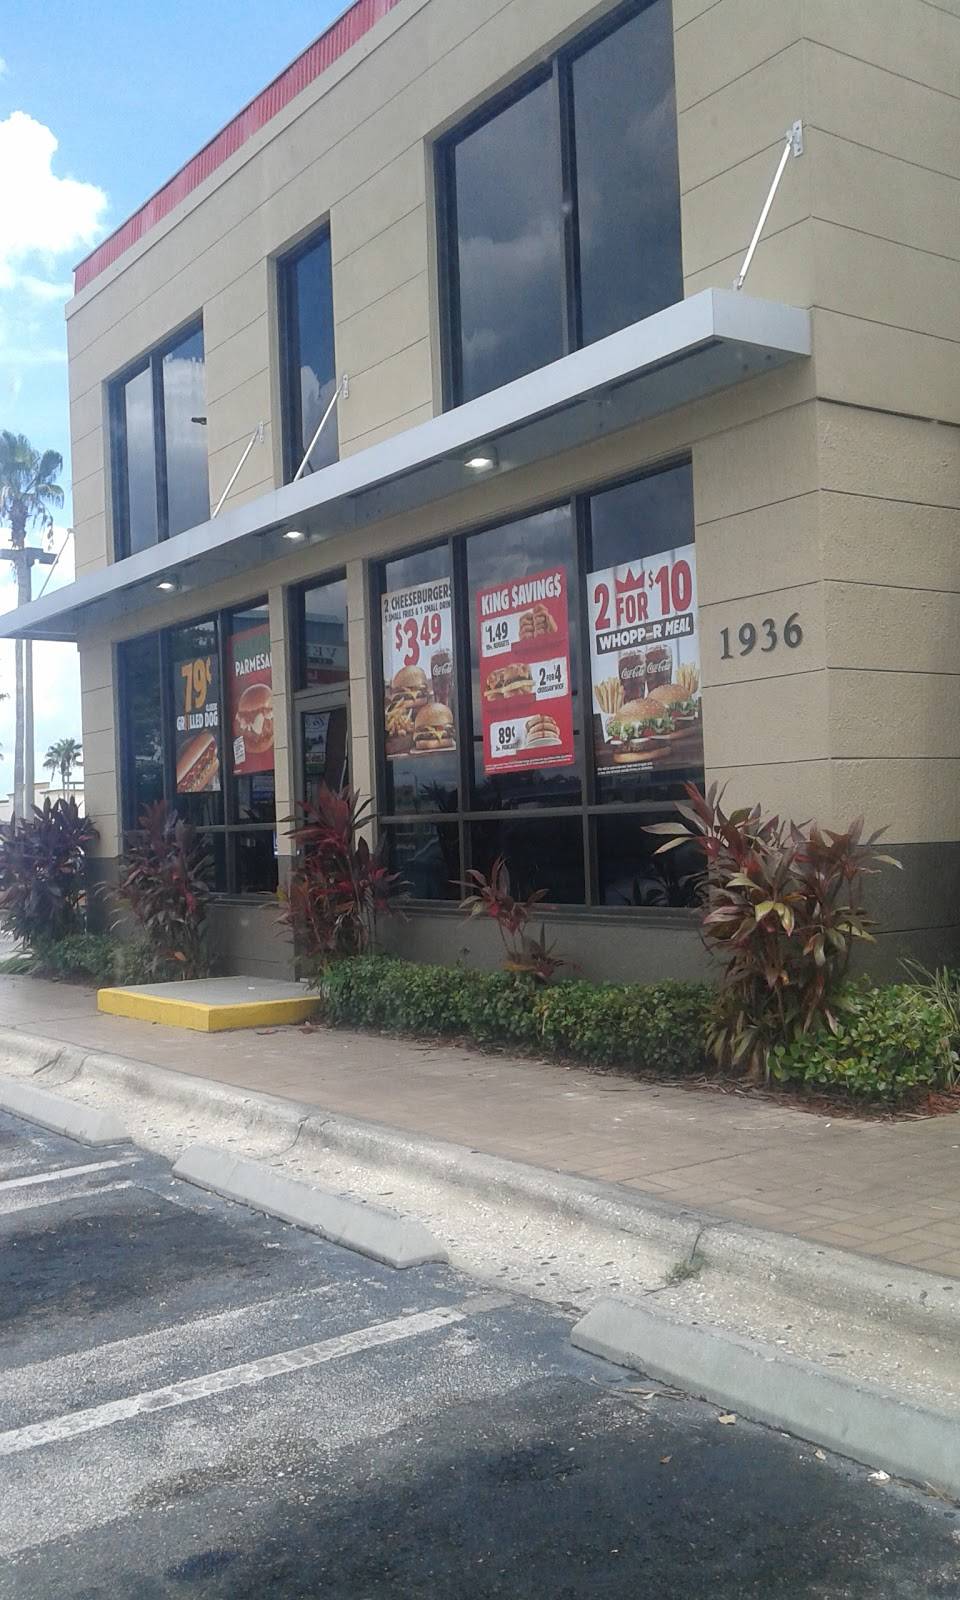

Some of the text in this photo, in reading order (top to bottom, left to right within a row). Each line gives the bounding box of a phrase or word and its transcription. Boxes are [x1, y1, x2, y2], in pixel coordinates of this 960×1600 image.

[481, 588, 510, 616] KING
[594, 559, 692, 631] 2 FOR $10
[384, 599, 389, 612] 2
[388, 611, 401, 621] SMALL
[402, 607, 414, 618] FRIES
[424, 603, 438, 613] SMALL
[664, 616, 691, 636] MEAL
[720, 612, 803, 660] 1936
[539, 667, 546, 686] 2
[204, 711, 218, 727] DOG
